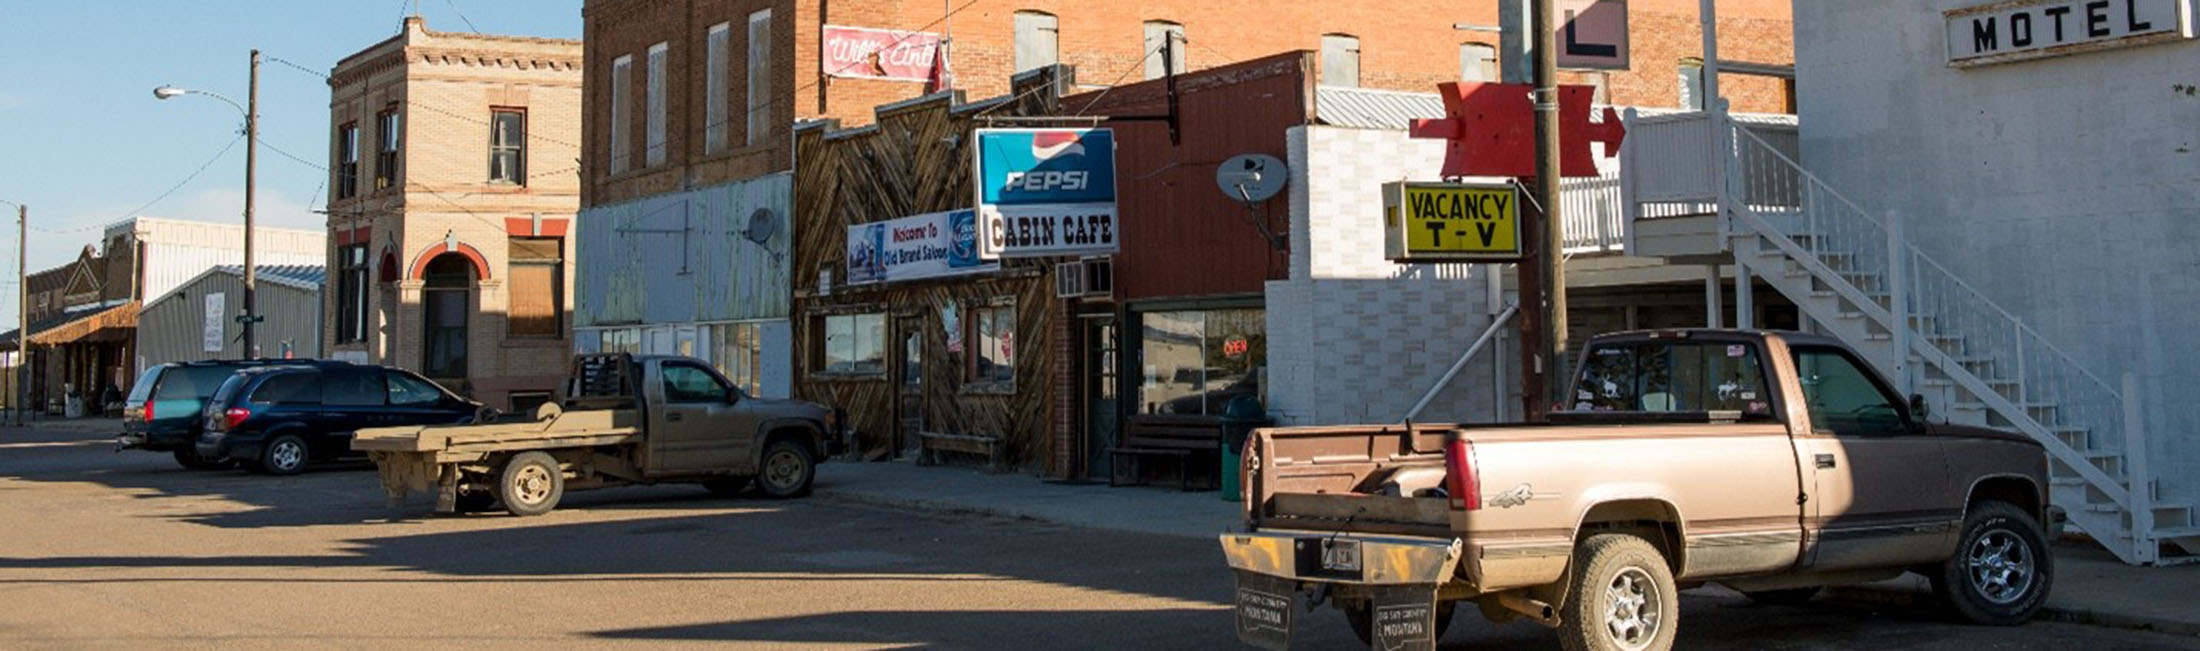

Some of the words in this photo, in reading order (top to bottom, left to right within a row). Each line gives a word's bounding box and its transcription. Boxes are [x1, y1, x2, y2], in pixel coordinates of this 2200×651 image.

[1564, 9, 1617, 57] L
[1973, 0, 2151, 53] MOTEL
[1005, 170, 1089, 192] PEPSI
[1410, 192, 1509, 220] VACANCY
[893, 225, 927, 243] Welcome
[928, 221, 938, 238] To
[992, 216, 1056, 248] CABIN
[1062, 214, 1113, 245] CAFE
[885, 249, 898, 266] Old
[899, 245, 922, 264] Brand
[923, 244, 948, 261] Saloon
[1244, 606, 1281, 625] MONTANA
[1384, 621, 1423, 637] MONTANA
